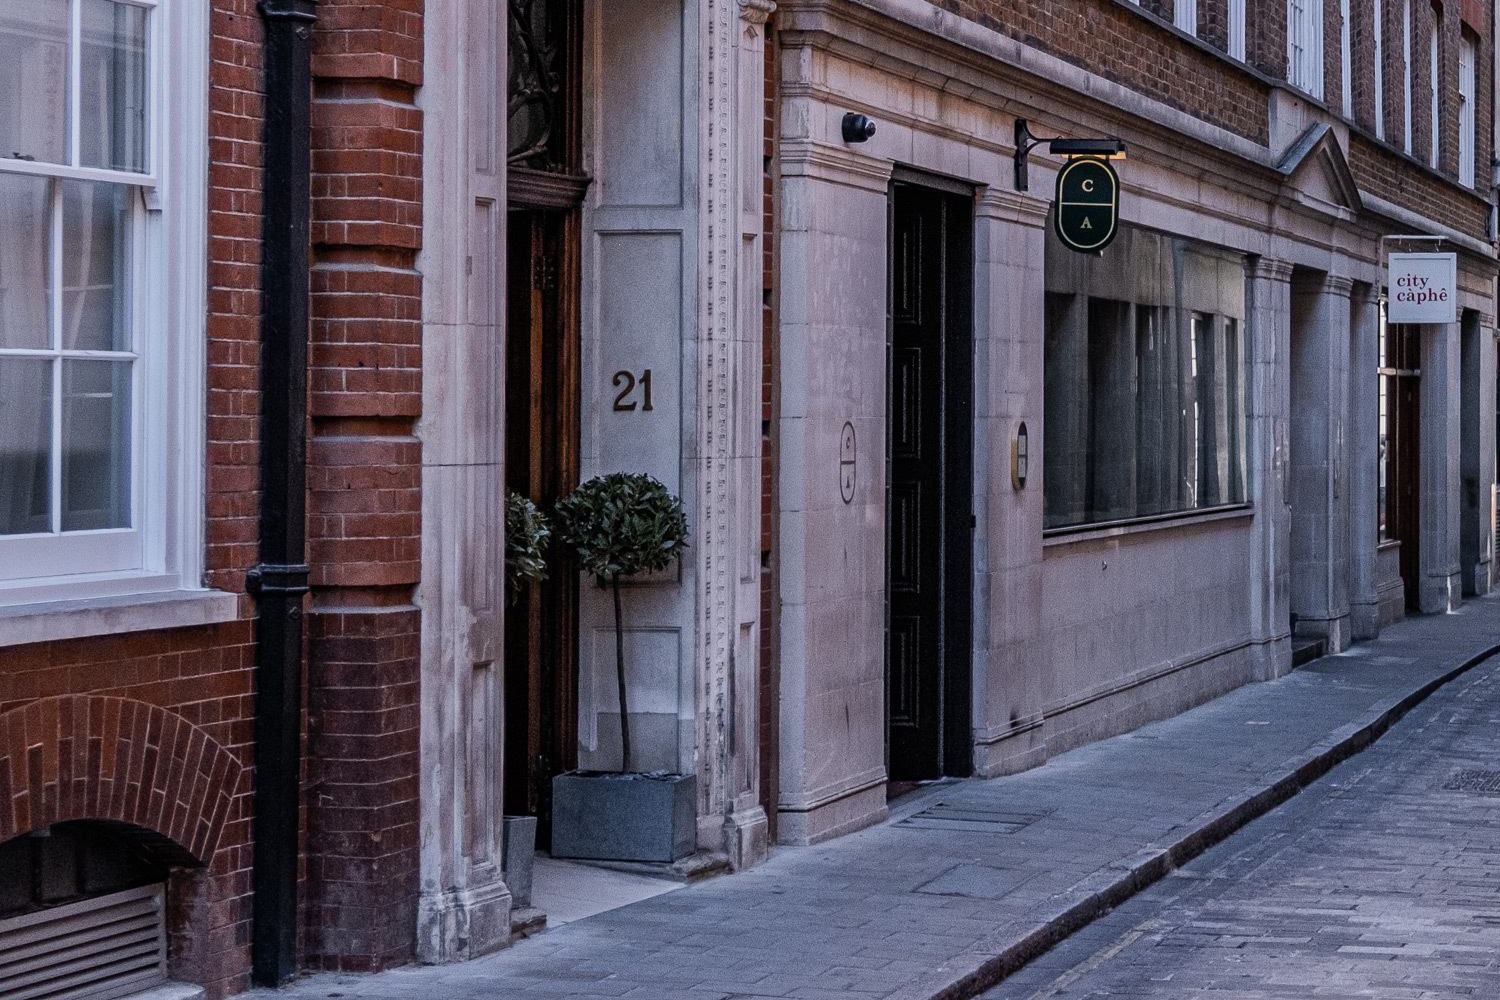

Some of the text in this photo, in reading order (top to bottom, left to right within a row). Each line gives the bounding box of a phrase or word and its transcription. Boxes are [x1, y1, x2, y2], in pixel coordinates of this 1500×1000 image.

[1081, 179, 1094, 193] C
[1080, 216, 1093, 229] A
[1396, 273, 1430, 290] city
[1396, 287, 1448, 305] càphê
[612, 368, 654, 412] 21
